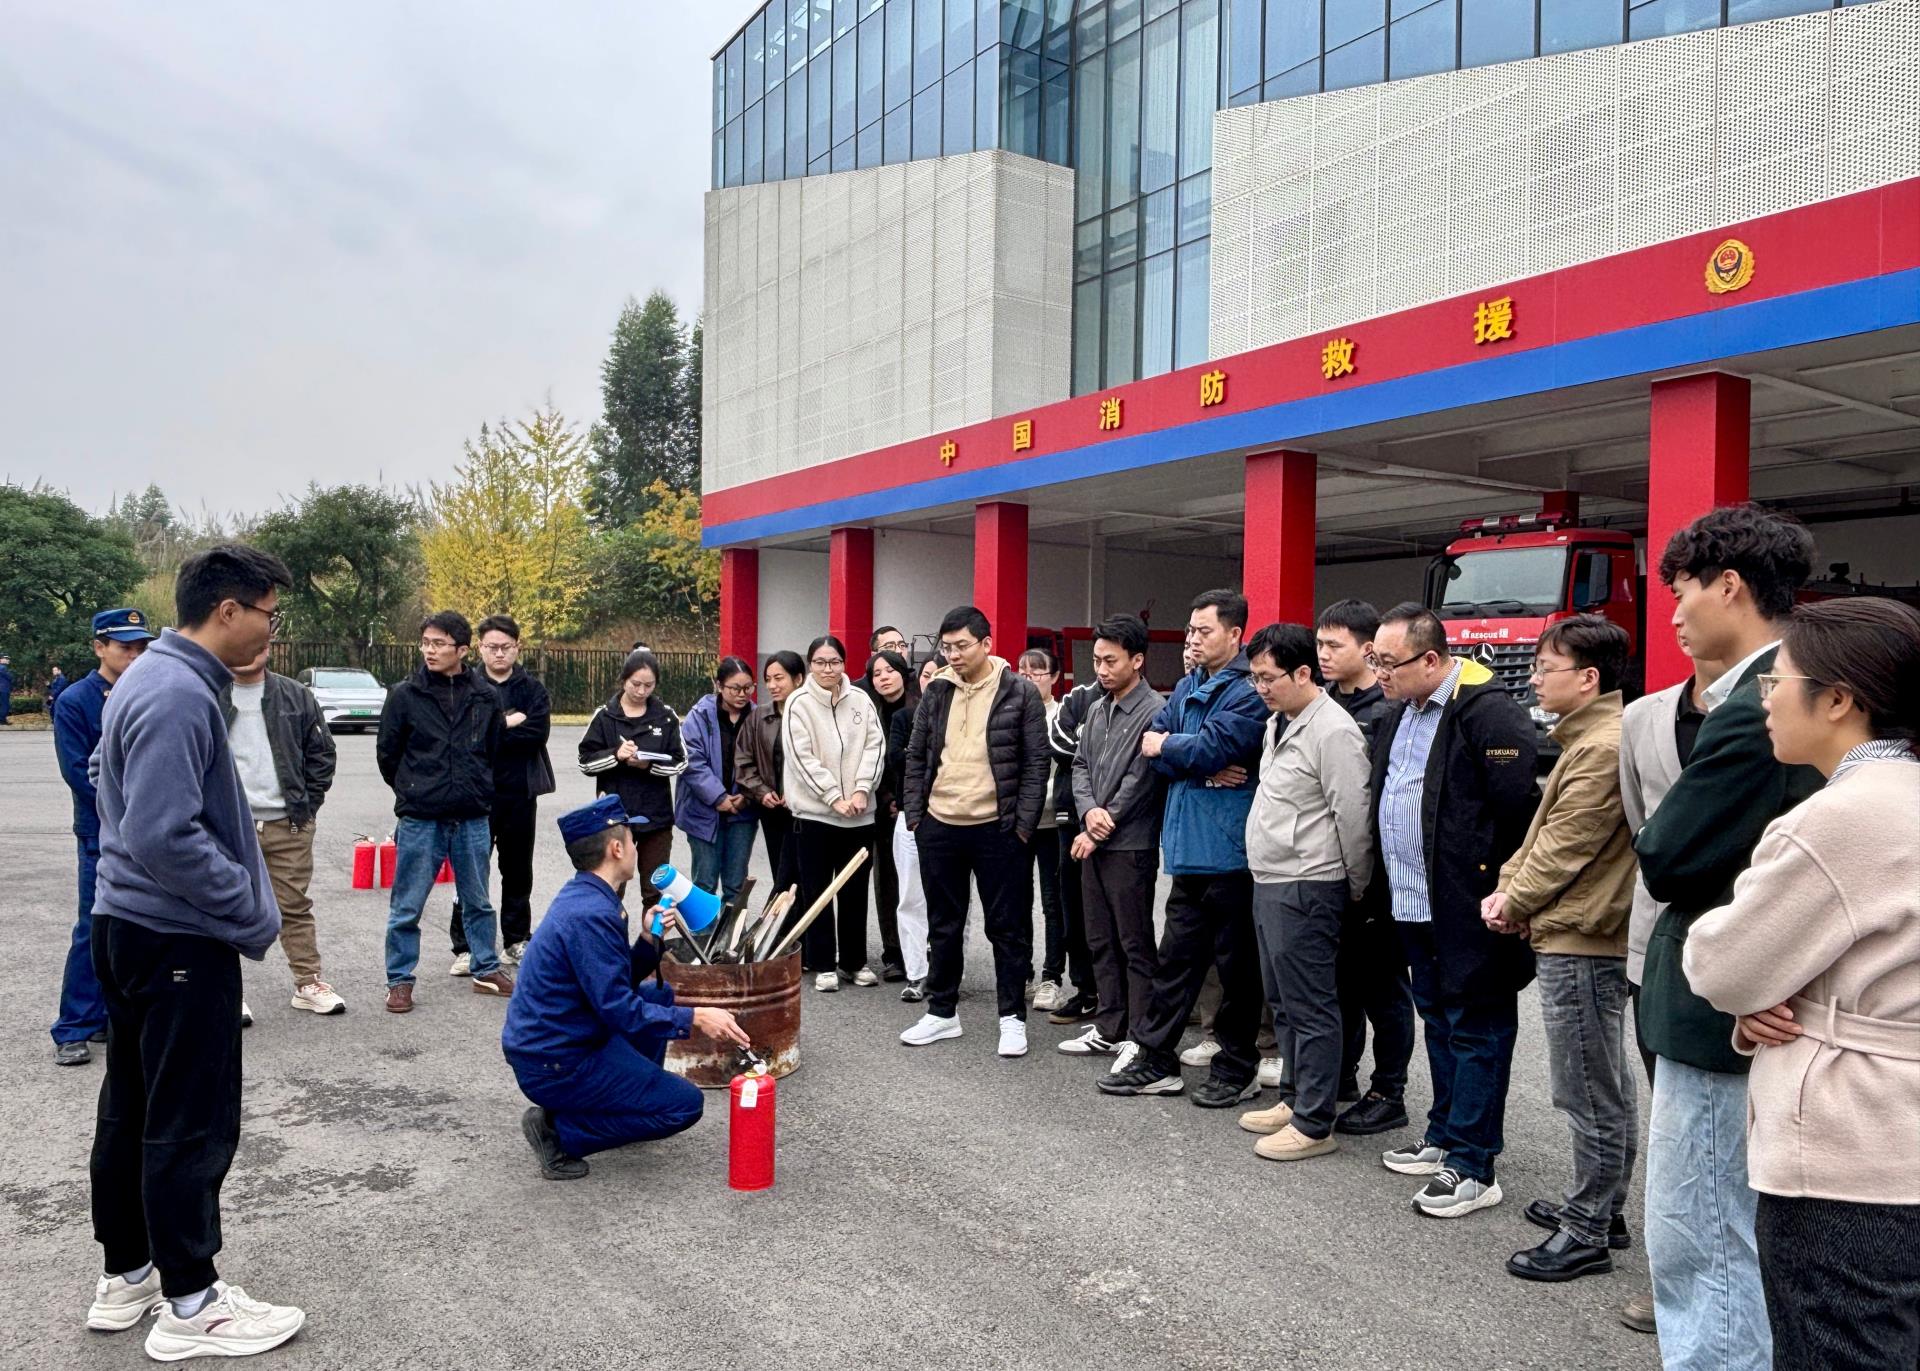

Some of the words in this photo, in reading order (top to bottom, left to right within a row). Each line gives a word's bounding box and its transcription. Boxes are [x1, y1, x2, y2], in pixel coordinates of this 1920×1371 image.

[939, 296, 1514, 467] 中国消防救援
